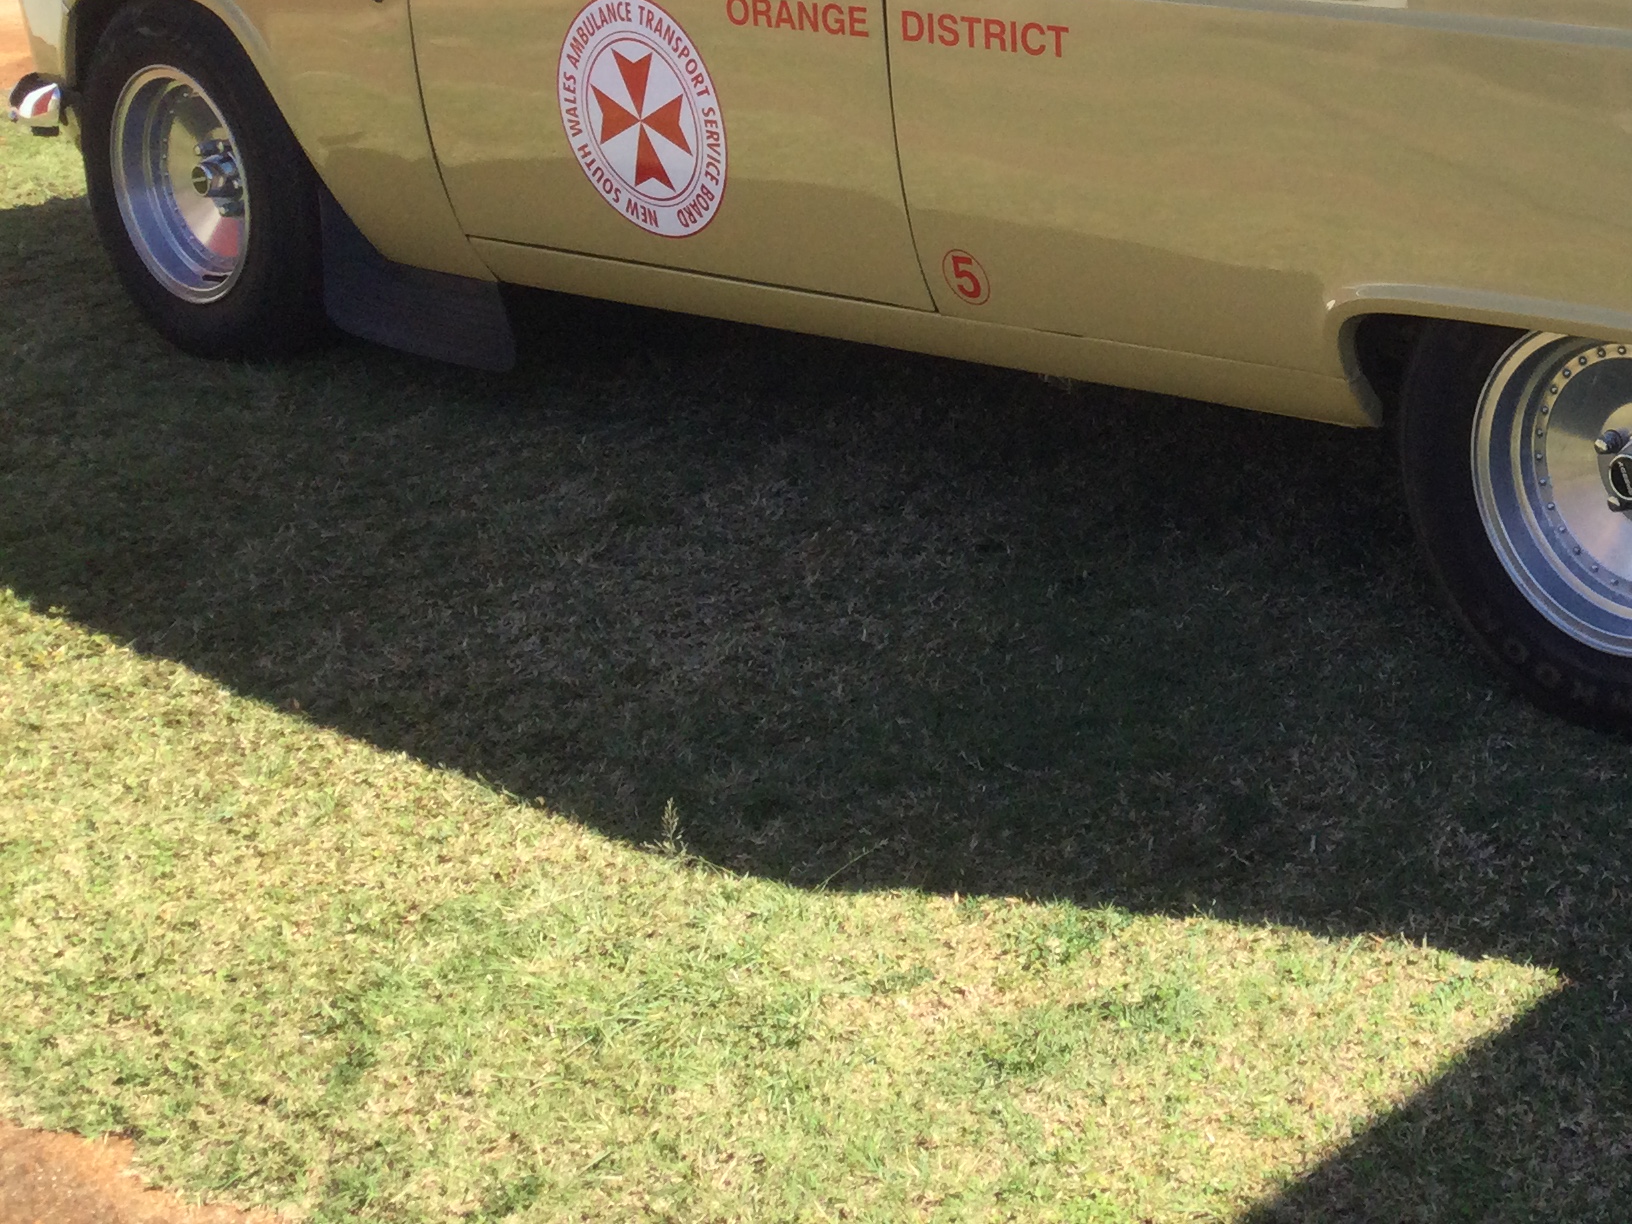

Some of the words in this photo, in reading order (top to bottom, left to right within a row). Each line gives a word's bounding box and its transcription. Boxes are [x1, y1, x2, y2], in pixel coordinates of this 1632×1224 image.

[566, 1, 632, 70] AMBULANCE
[637, 5, 711, 97] TRANSPORT
[901, 10, 1069, 58] DISTRICT
[563, 71, 584, 138] WALES
[577, 143, 622, 204] SOUTH
[702, 107, 722, 186] SERVICE
[625, 198, 659, 228] NEW
[677, 183, 716, 228] BOARD
[951, 255, 982, 298] 5
